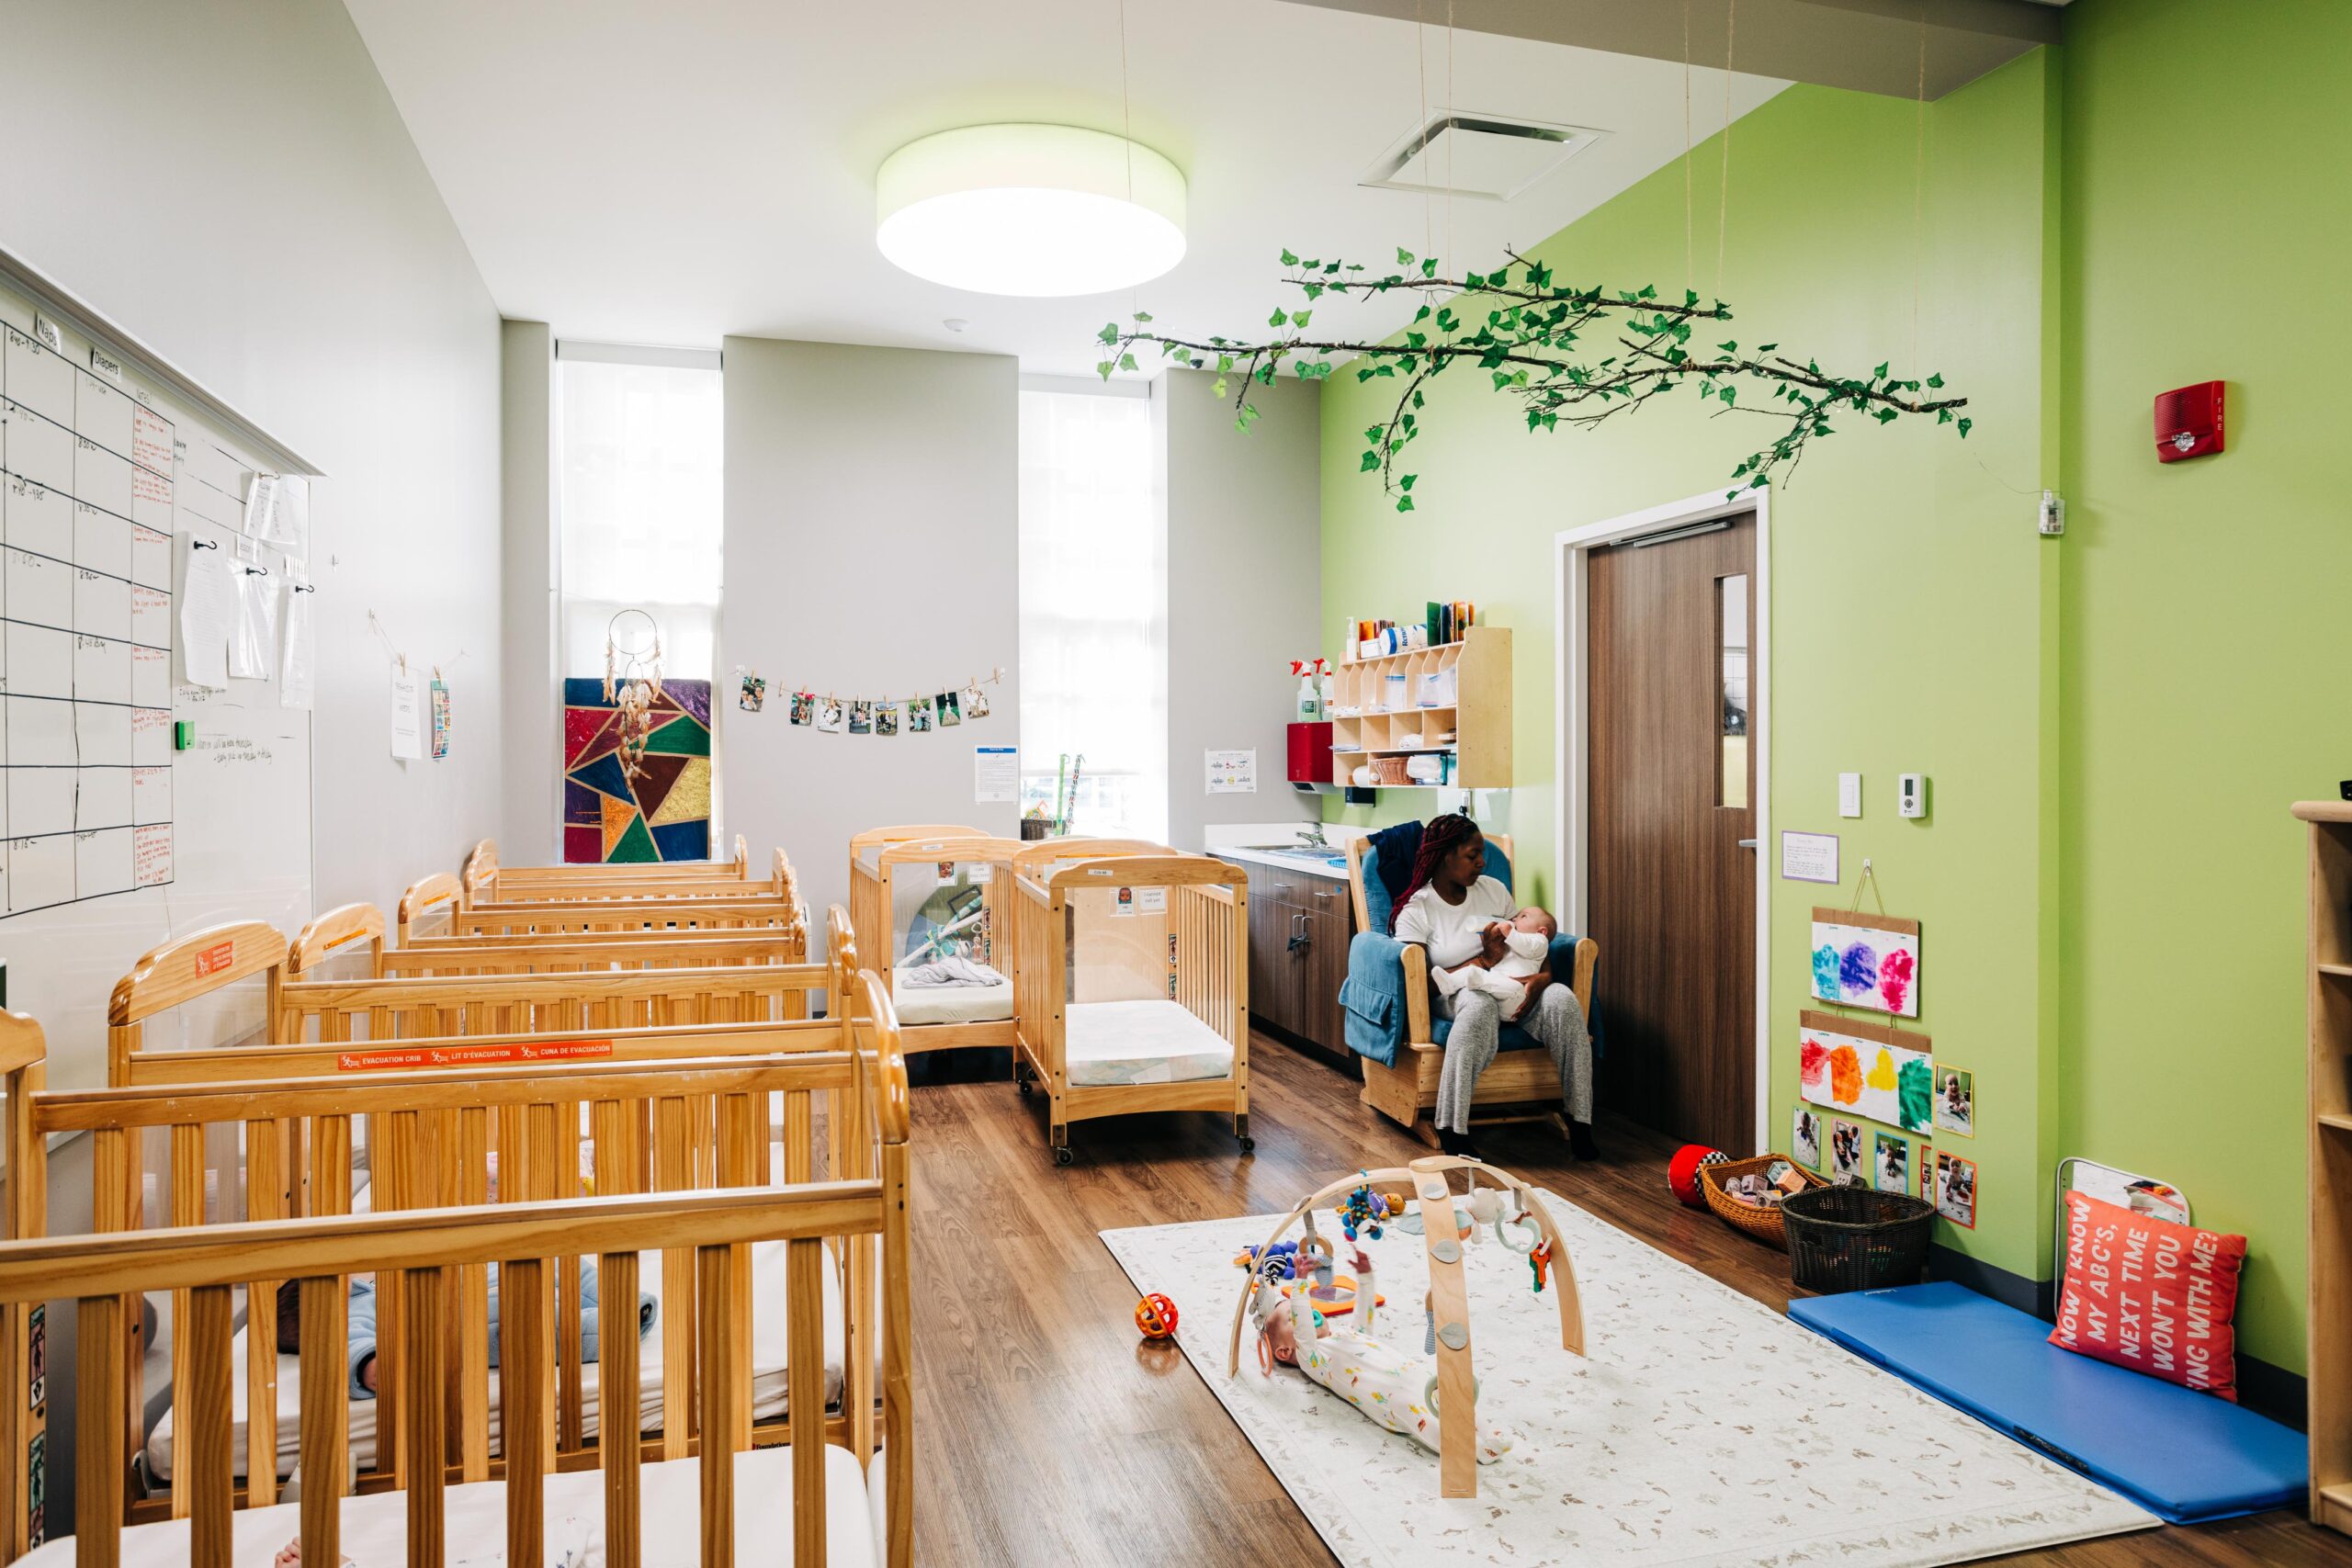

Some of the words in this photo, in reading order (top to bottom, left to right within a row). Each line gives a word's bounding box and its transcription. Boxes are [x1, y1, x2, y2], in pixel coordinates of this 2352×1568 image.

[39, 319, 57, 346] Naps
[95, 351, 119, 375] Diapers
[362, 1055, 403, 1065] EVACUATION
[451, 1052, 461, 1060] LIT
[463, 1050, 511, 1059] D'ÉVACUATION
[570, 1044, 610, 1054] EVACUACIÓN
[2069, 1199, 2092, 1270] KNOW
[2121, 1227, 2149, 1282] TIME
[2190, 1232, 2219, 1274] ME?
[2089, 1224, 2120, 1299] ABC'S,
[2154, 1235, 2181, 1280] YOU
[2069, 1277, 2082, 1285] I
[2060, 1289, 2081, 1347] NOW
[2086, 1303, 2109, 1343] MY
[2120, 1291, 2141, 1359] NEXT
[2187, 1275, 2212, 1339] WITH
[2151, 1291, 2175, 1371] WON'T
